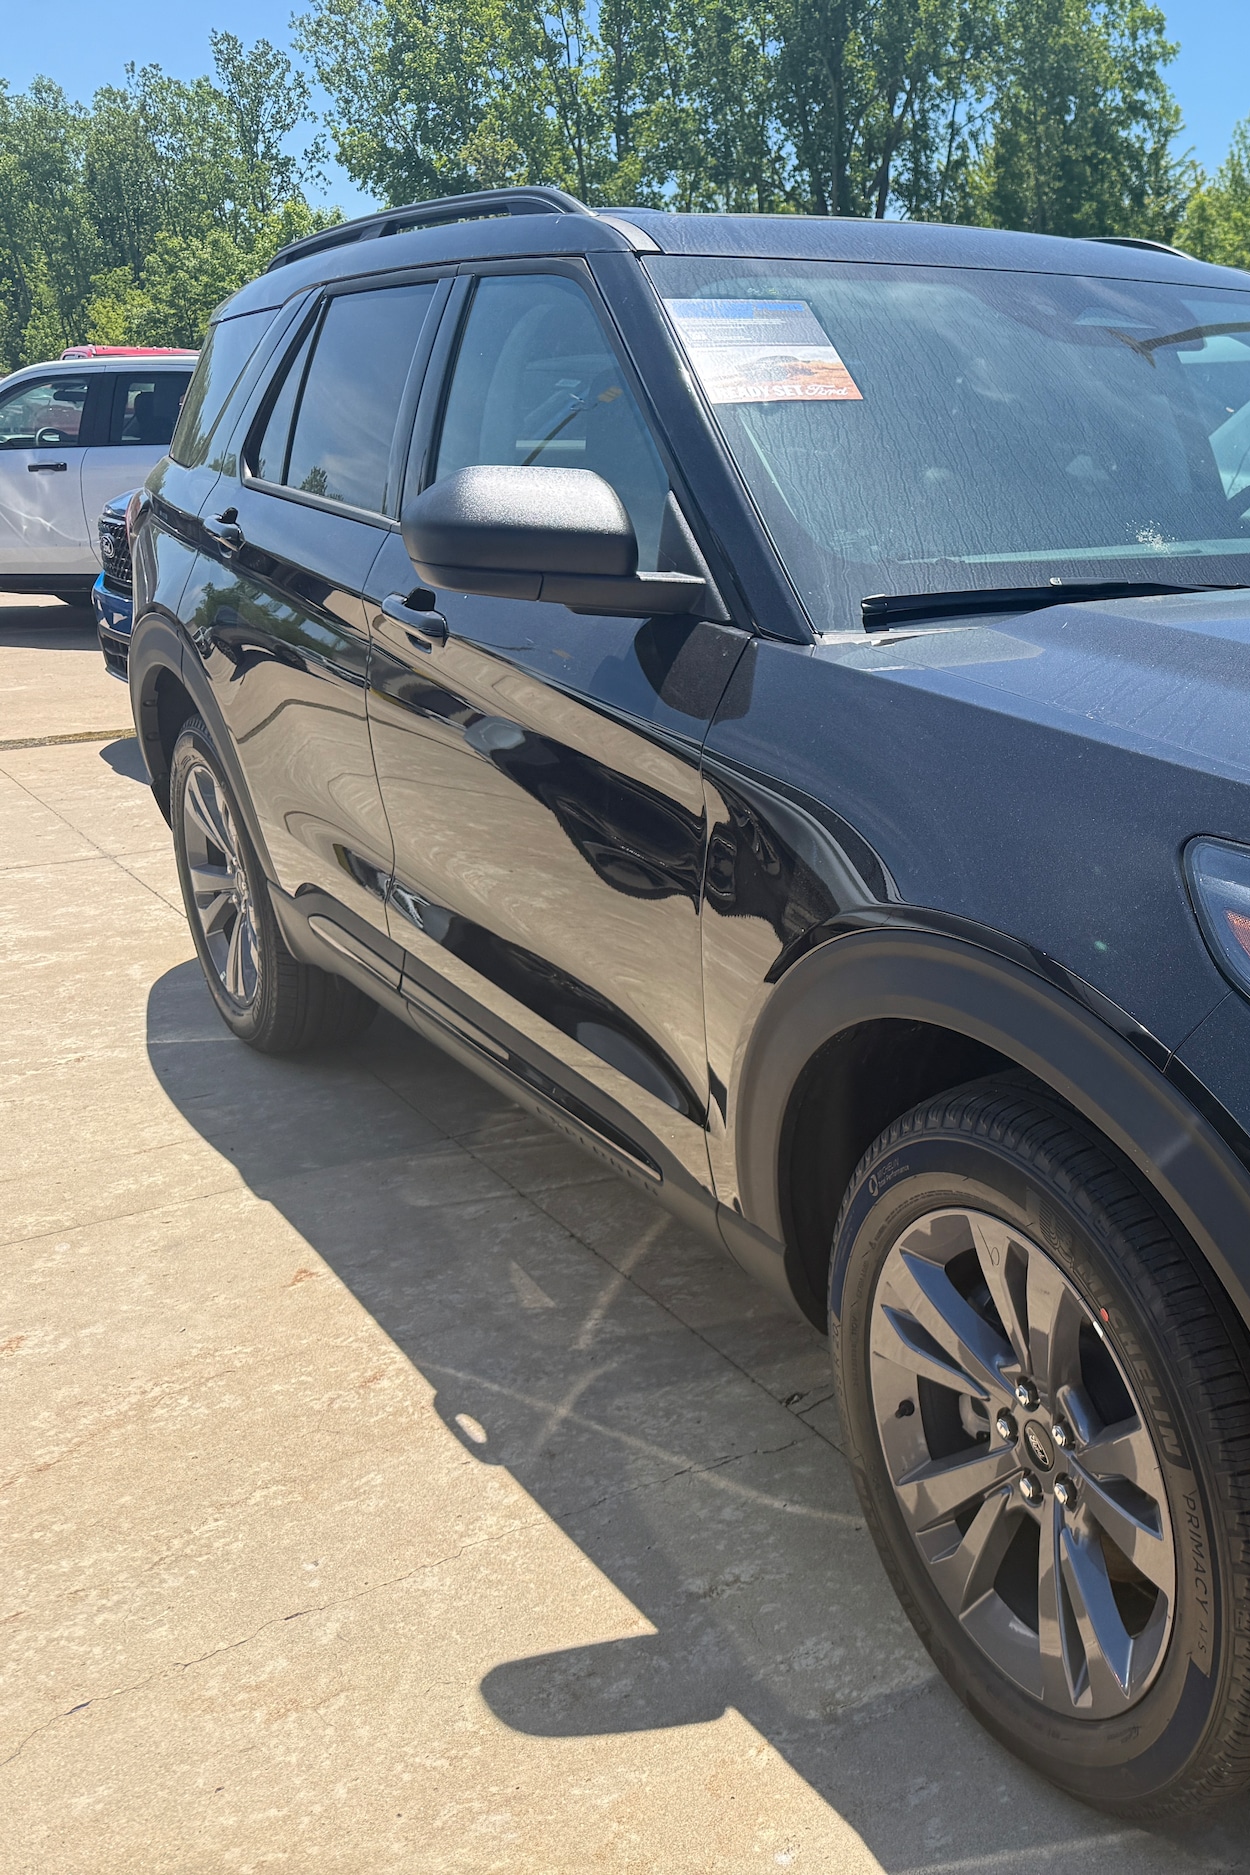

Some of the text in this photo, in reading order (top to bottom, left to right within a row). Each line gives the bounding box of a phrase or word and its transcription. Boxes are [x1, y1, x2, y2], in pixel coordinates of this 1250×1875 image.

[715, 384, 849, 399] READY SET Ford
[1077, 1263, 1183, 1458] MICHELIN
[1182, 1492, 1209, 1655] PRIMACY A/S
